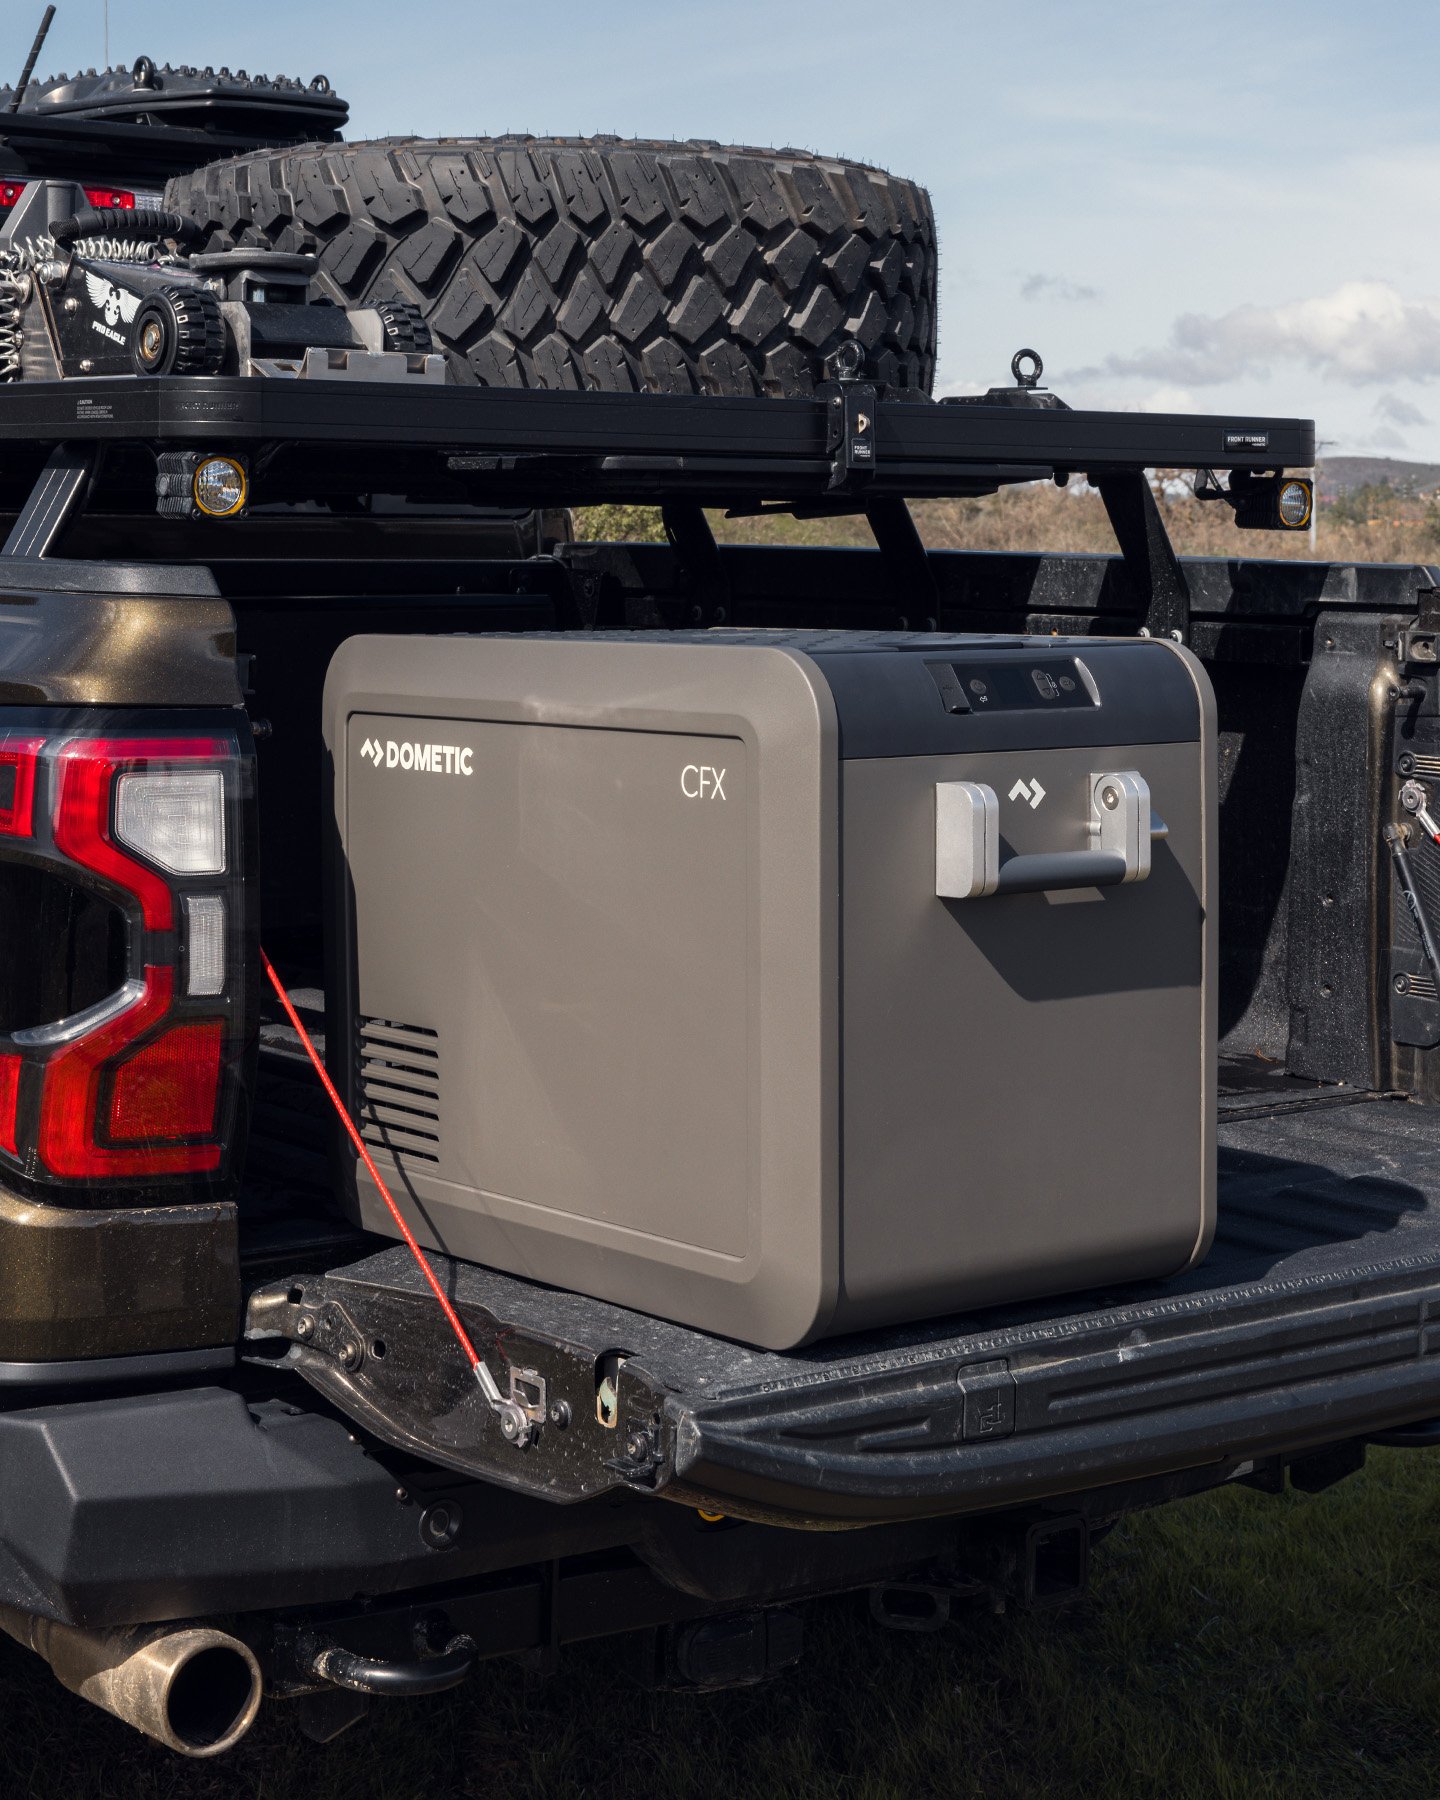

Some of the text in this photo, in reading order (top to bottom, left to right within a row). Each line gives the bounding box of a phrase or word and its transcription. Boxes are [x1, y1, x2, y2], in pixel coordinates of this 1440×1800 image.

[92, 320, 126, 346] PRO EAGLE
[386, 740, 474, 776] DOMETIC
[681, 764, 727, 801] CFX
